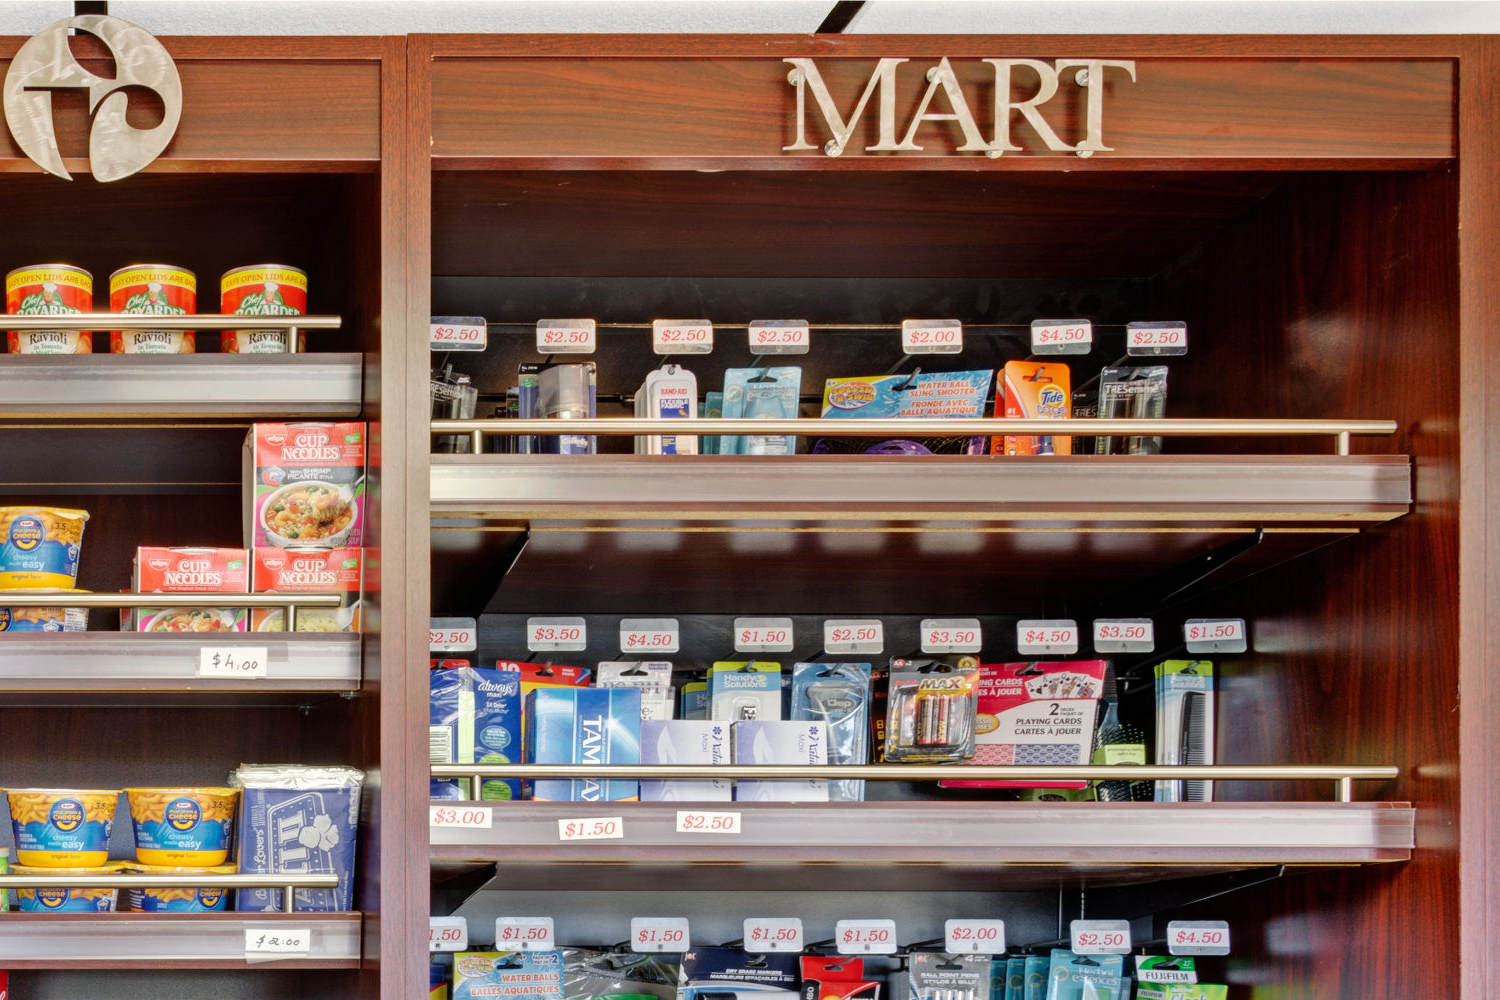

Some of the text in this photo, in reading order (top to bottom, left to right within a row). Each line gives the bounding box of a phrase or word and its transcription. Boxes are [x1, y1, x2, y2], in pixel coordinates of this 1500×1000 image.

[782, 57, 1137, 152] MART
[44, 272, 63, 281] LIDS
[126, 272, 168, 283] OPEN LIDS
[240, 272, 284, 283] OPEN LIDS
[22, 295, 41, 309] Chef
[127, 295, 146, 309] Chef
[242, 295, 262, 309] Chef
[29, 332, 67, 346] Ravioli
[134, 332, 172, 345] Ravioli
[434, 328, 479, 342] $2.50
[544, 330, 589, 344] $2.50
[661, 328, 706, 342] $2.50
[757, 329, 802, 343] $2.50
[910, 330, 955, 343] $2.00
[1039, 328, 1084, 342] $4.50
[1133, 331, 1179, 345] $2.50
[918, 379, 970, 389] WATER BALL
[660, 388, 687, 396] BAND-AID
[909, 388, 976, 398] SLING SHOOTER
[1042, 390, 1064, 403] Tide
[911, 399, 969, 408] FRONDE AVEC
[926, 406, 977, 415] AQUATIQUE
[295, 434, 330, 448] CUP
[282, 447, 341, 461] NOODLES
[13, 553, 38, 563] cheesy
[22, 560, 45, 571] easy
[177, 559, 212, 573] CUP
[292, 559, 327, 573] CUP
[164, 571, 223, 586] NOODLES
[279, 571, 337, 586] NOODLES
[534, 628, 580, 641] $3.50
[740, 630, 786, 643] $1.50
[831, 628, 877, 642] $2.50
[929, 630, 975, 644] $3.50
[1025, 630, 1071, 643] $4.50
[1100, 626, 1146, 639] $3.50
[1189, 625, 1235, 638] $1.50
[627, 634, 672, 647] $4.50
[477, 680, 513, 697] always
[723, 680, 767, 688] Solutions
[920, 679, 963, 689] MAX
[994, 678, 1024, 686] CARDS
[996, 687, 1023, 697] JOUER
[1049, 703, 1060, 716] 2
[1052, 717, 1082, 725] CARDS
[1054, 728, 1082, 736] JOUER
[434, 810, 485, 825] $3.00
[682, 816, 734, 830] $2.50
[564, 821, 616, 837] $1.50
[62, 840, 85, 851] easy
[178, 839, 202, 850] easy
[502, 927, 548, 941] $1.50
[638, 929, 684, 942] $1.50
[751, 928, 797, 941] $1.50
[843, 929, 889, 942] $1.50
[951, 927, 997, 941] $2.00
[1078, 932, 1124, 946] $2.50
[1176, 931, 1222, 944] $4.50
[502, 973, 560, 983] WATER BALLS
[1145, 971, 1189, 981] FUJIFILM
[471, 985, 560, 996] BALLES AQUATIQUES
